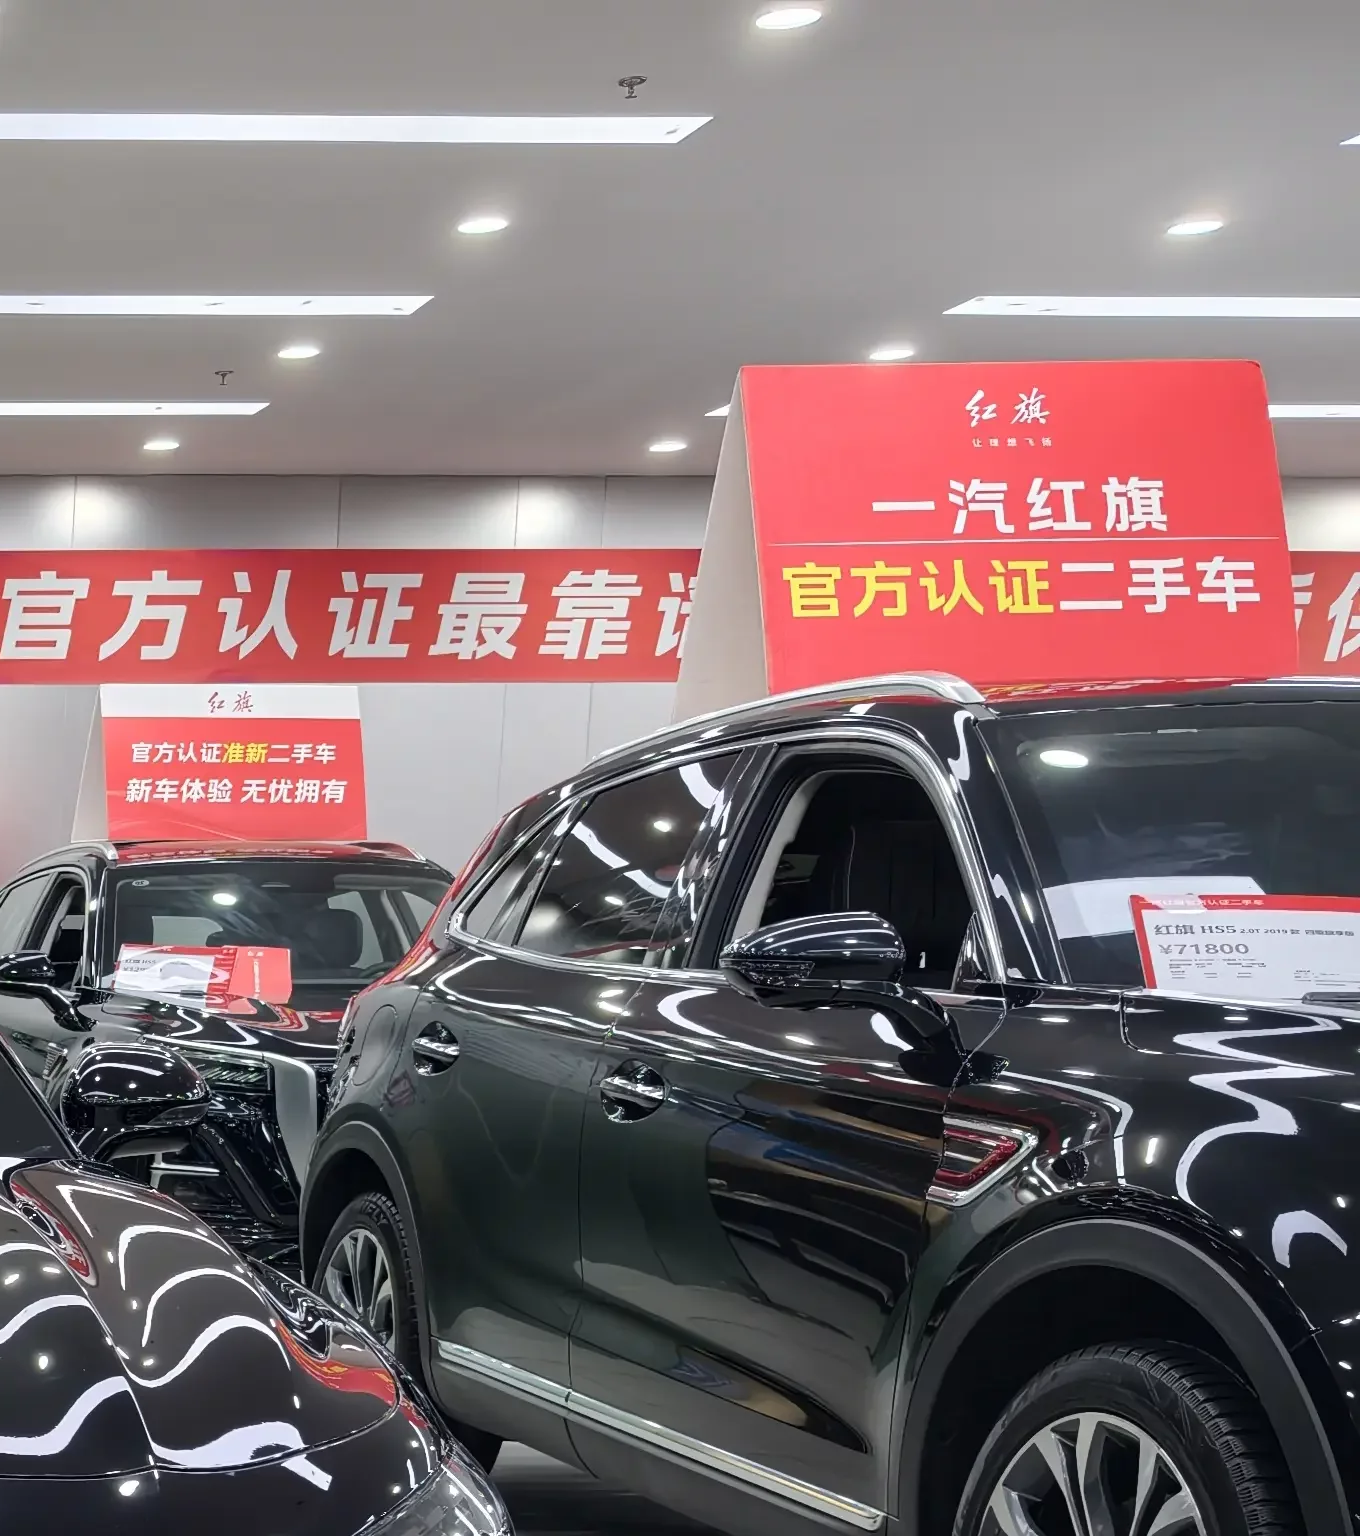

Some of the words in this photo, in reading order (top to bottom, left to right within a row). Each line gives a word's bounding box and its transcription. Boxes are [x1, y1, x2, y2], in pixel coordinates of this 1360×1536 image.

[964, 387, 1050, 428] 红旗
[871, 476, 1169, 534] 一汽红旗
[782, 556, 1261, 618] 官方认证二手车
[207, 691, 254, 715] 红旗
[130, 741, 337, 767] 官方认证准新二手车
[125, 777, 233, 806] 新车体验
[240, 777, 347, 806] 无忧拥有
[1154, 924, 1195, 935] 红旗
[1200, 925, 1236, 934] HS5
[1158, 943, 1249, 955] ¥71800
